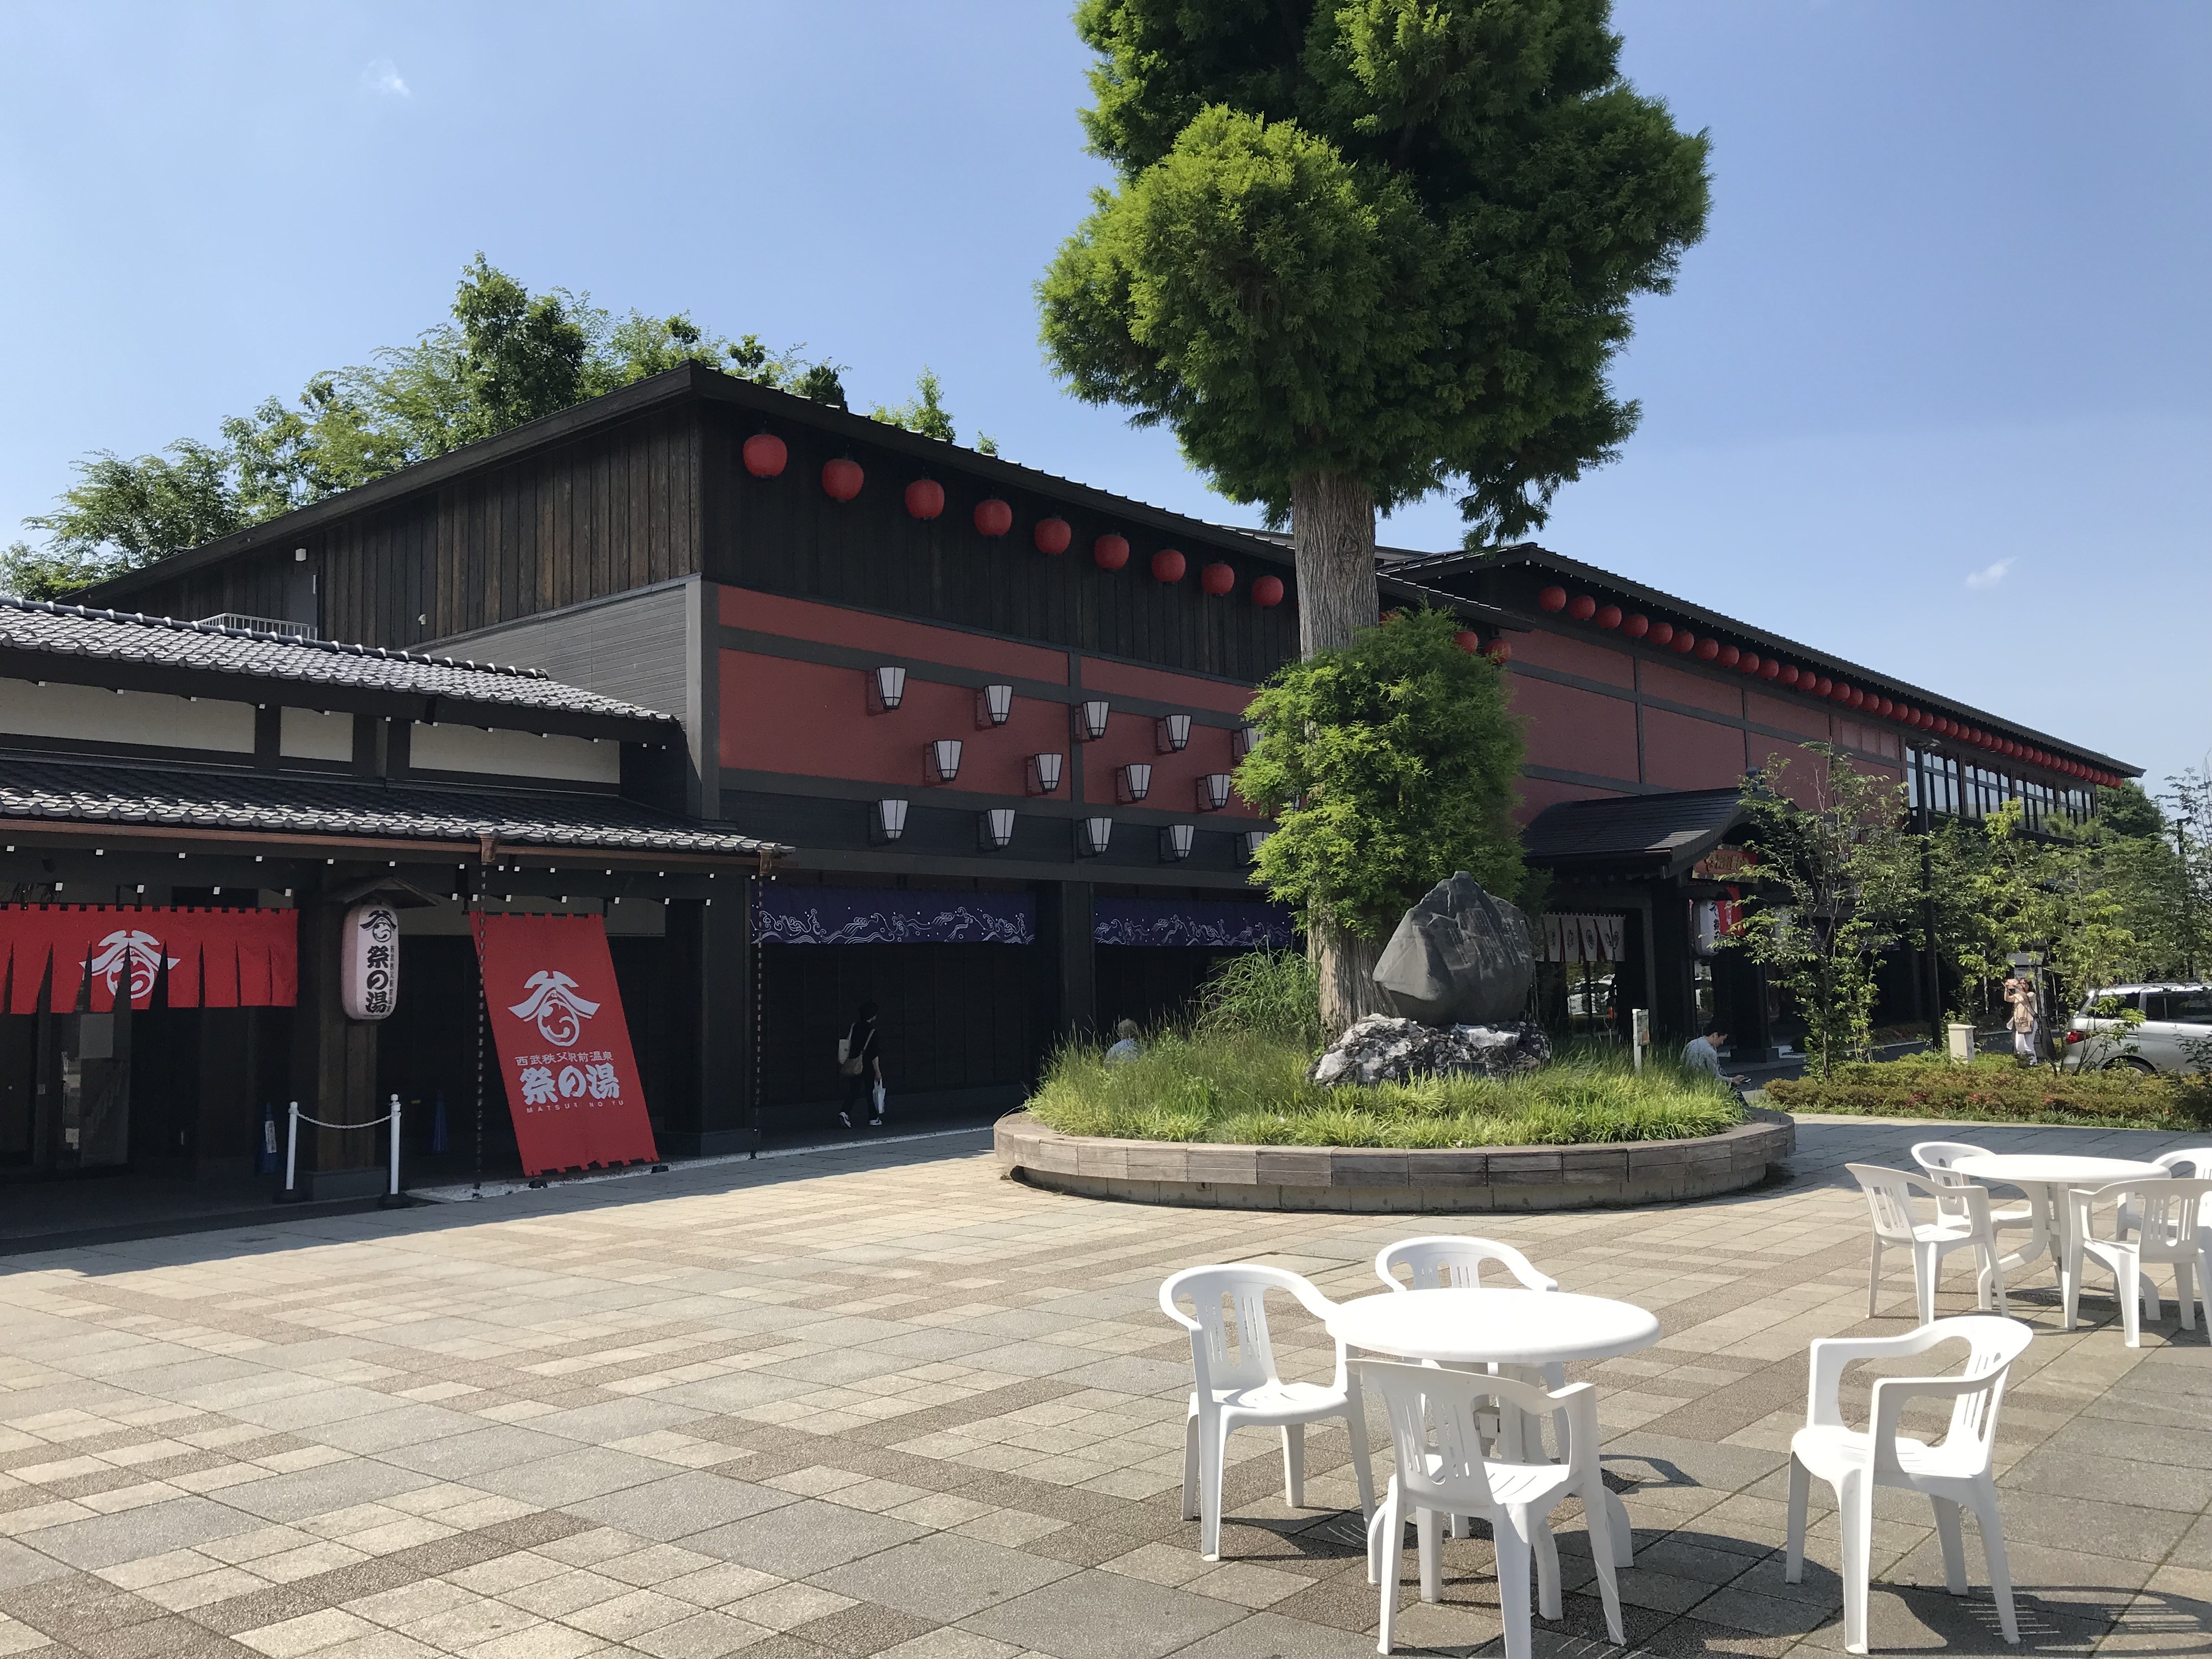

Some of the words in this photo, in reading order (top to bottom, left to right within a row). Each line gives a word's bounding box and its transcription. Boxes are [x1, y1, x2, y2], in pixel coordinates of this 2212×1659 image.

[365, 945, 390, 1013] 祭の湯
[515, 1051, 614, 1066] 西武秩父駅前温泉
[520, 1062, 619, 1105] 祭の湯
